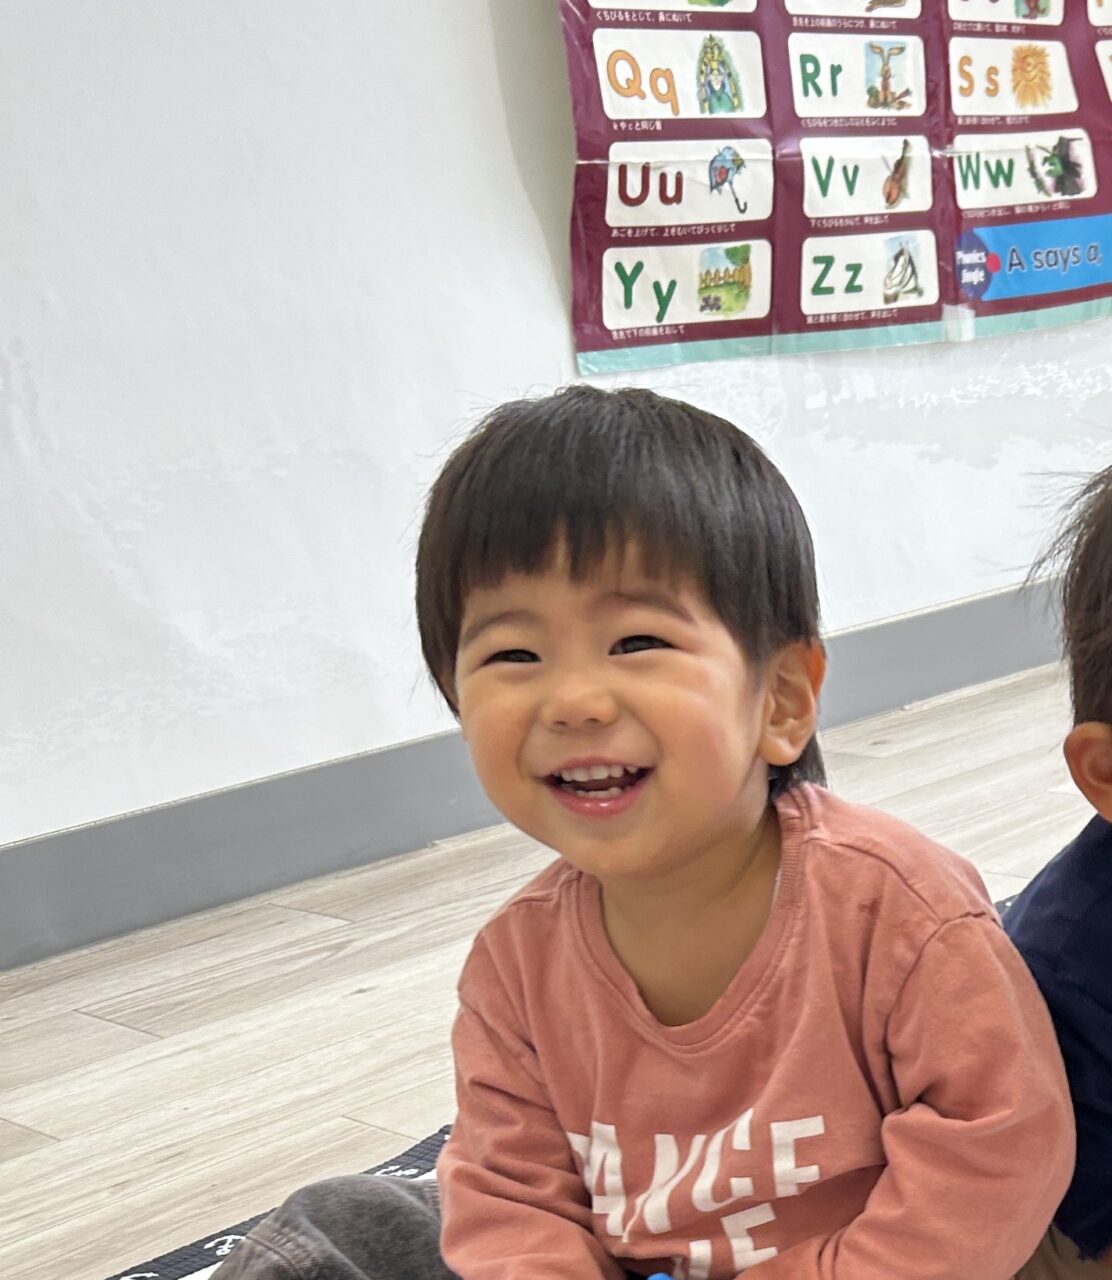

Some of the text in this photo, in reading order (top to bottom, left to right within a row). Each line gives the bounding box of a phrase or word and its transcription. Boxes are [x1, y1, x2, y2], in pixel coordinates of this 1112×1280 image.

[606, 49, 680, 117] Qq
[799, 53, 843, 98] Rr
[958, 55, 1000, 97] Ss
[617, 162, 685, 207] Uu
[811, 155, 860, 198] Vv
[957, 151, 1014, 190] Ww
[811, 254, 864, 296] Zz
[1008, 247, 1025, 273] A
[1032, 244, 1081, 273] says
[614, 260, 677, 324] Yy
